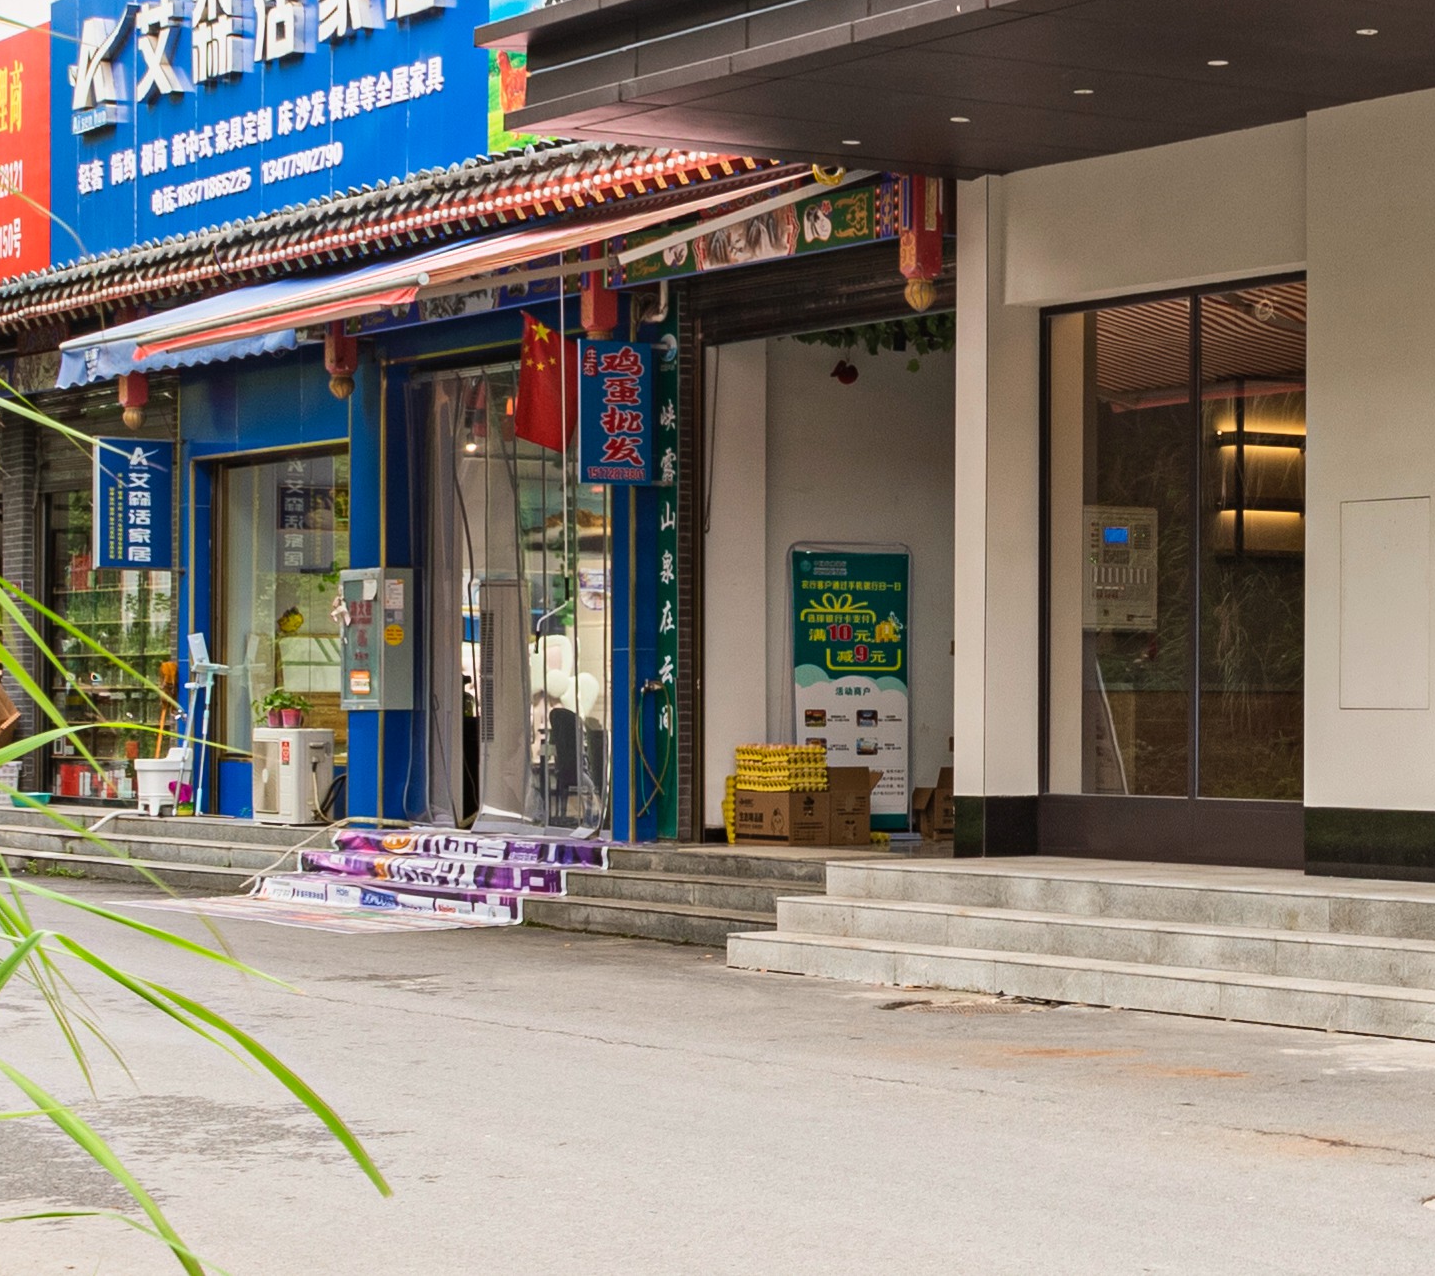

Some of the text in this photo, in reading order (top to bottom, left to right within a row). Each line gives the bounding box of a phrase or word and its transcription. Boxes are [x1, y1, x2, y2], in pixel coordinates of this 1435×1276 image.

[599, 346, 645, 465] 鸡蛋批发
[128, 473, 151, 563] 艾森活家居
[836, 644, 886, 663] 减9元
